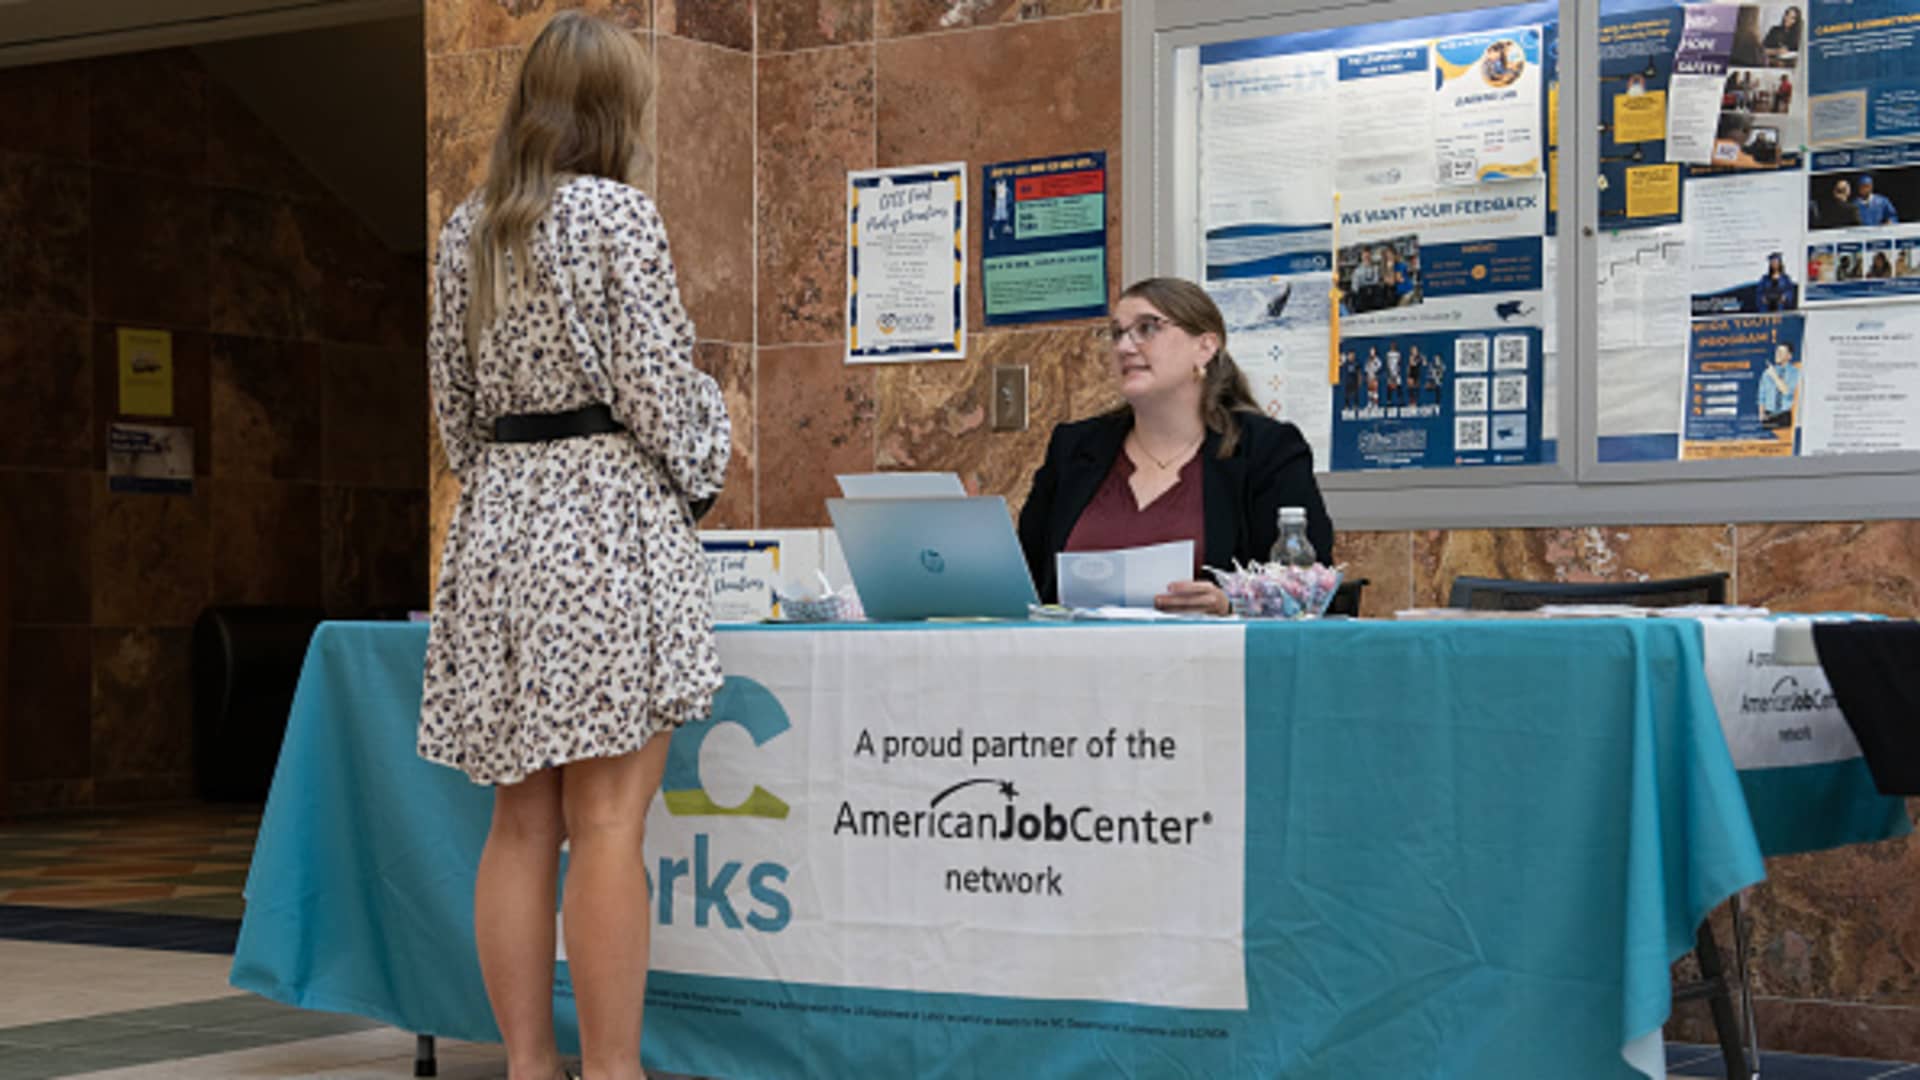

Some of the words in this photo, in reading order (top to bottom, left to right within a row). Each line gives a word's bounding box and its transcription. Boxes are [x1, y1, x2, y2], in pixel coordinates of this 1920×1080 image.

[1341, 211, 1361, 225] WE
[1364, 206, 1407, 222] WANT
[1409, 201, 1453, 218] YOUR
[1454, 194, 1538, 215] FEEDBACK
[855, 729, 875, 757] A
[882, 728, 964, 764] proud
[972, 731, 1078, 765] partner
[1086, 727, 1118, 759] of
[1126, 729, 1177, 761] the
[648, 832, 793, 934] rks
[946, 865, 1064, 896] network
